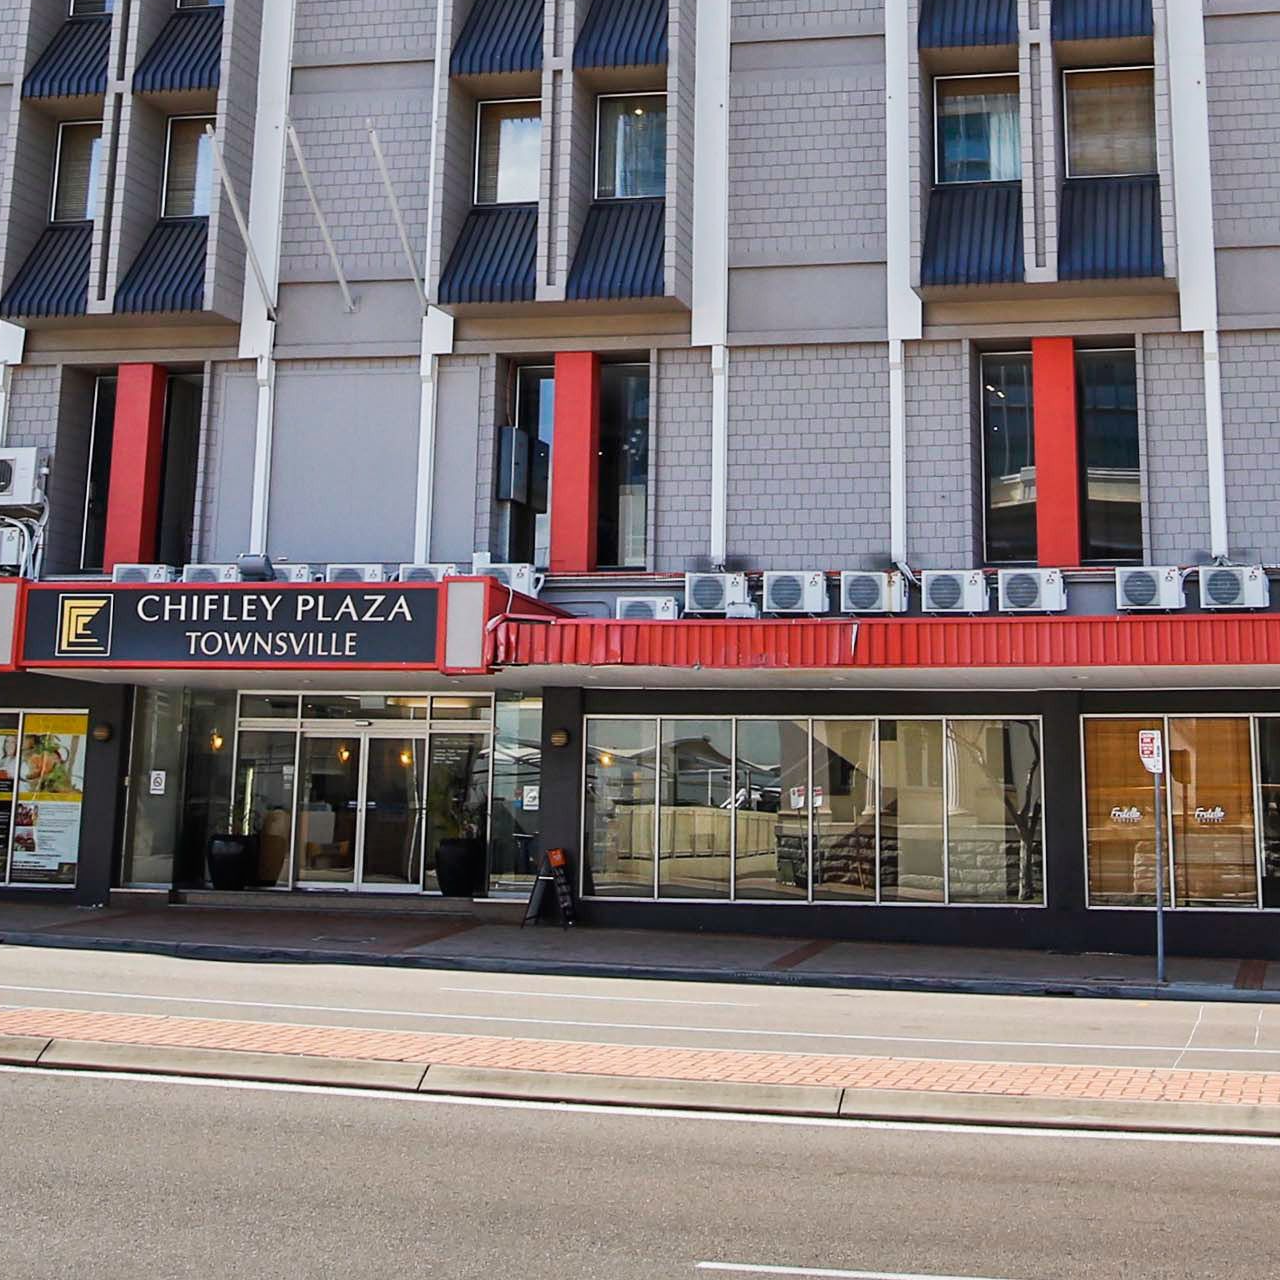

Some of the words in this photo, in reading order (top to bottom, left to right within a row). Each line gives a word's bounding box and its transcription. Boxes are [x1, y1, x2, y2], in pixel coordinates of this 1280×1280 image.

[136, 594, 284, 621] CHIFLEY
[296, 594, 413, 621] PLAZA
[185, 632, 358, 657] TOWNSVILLE
